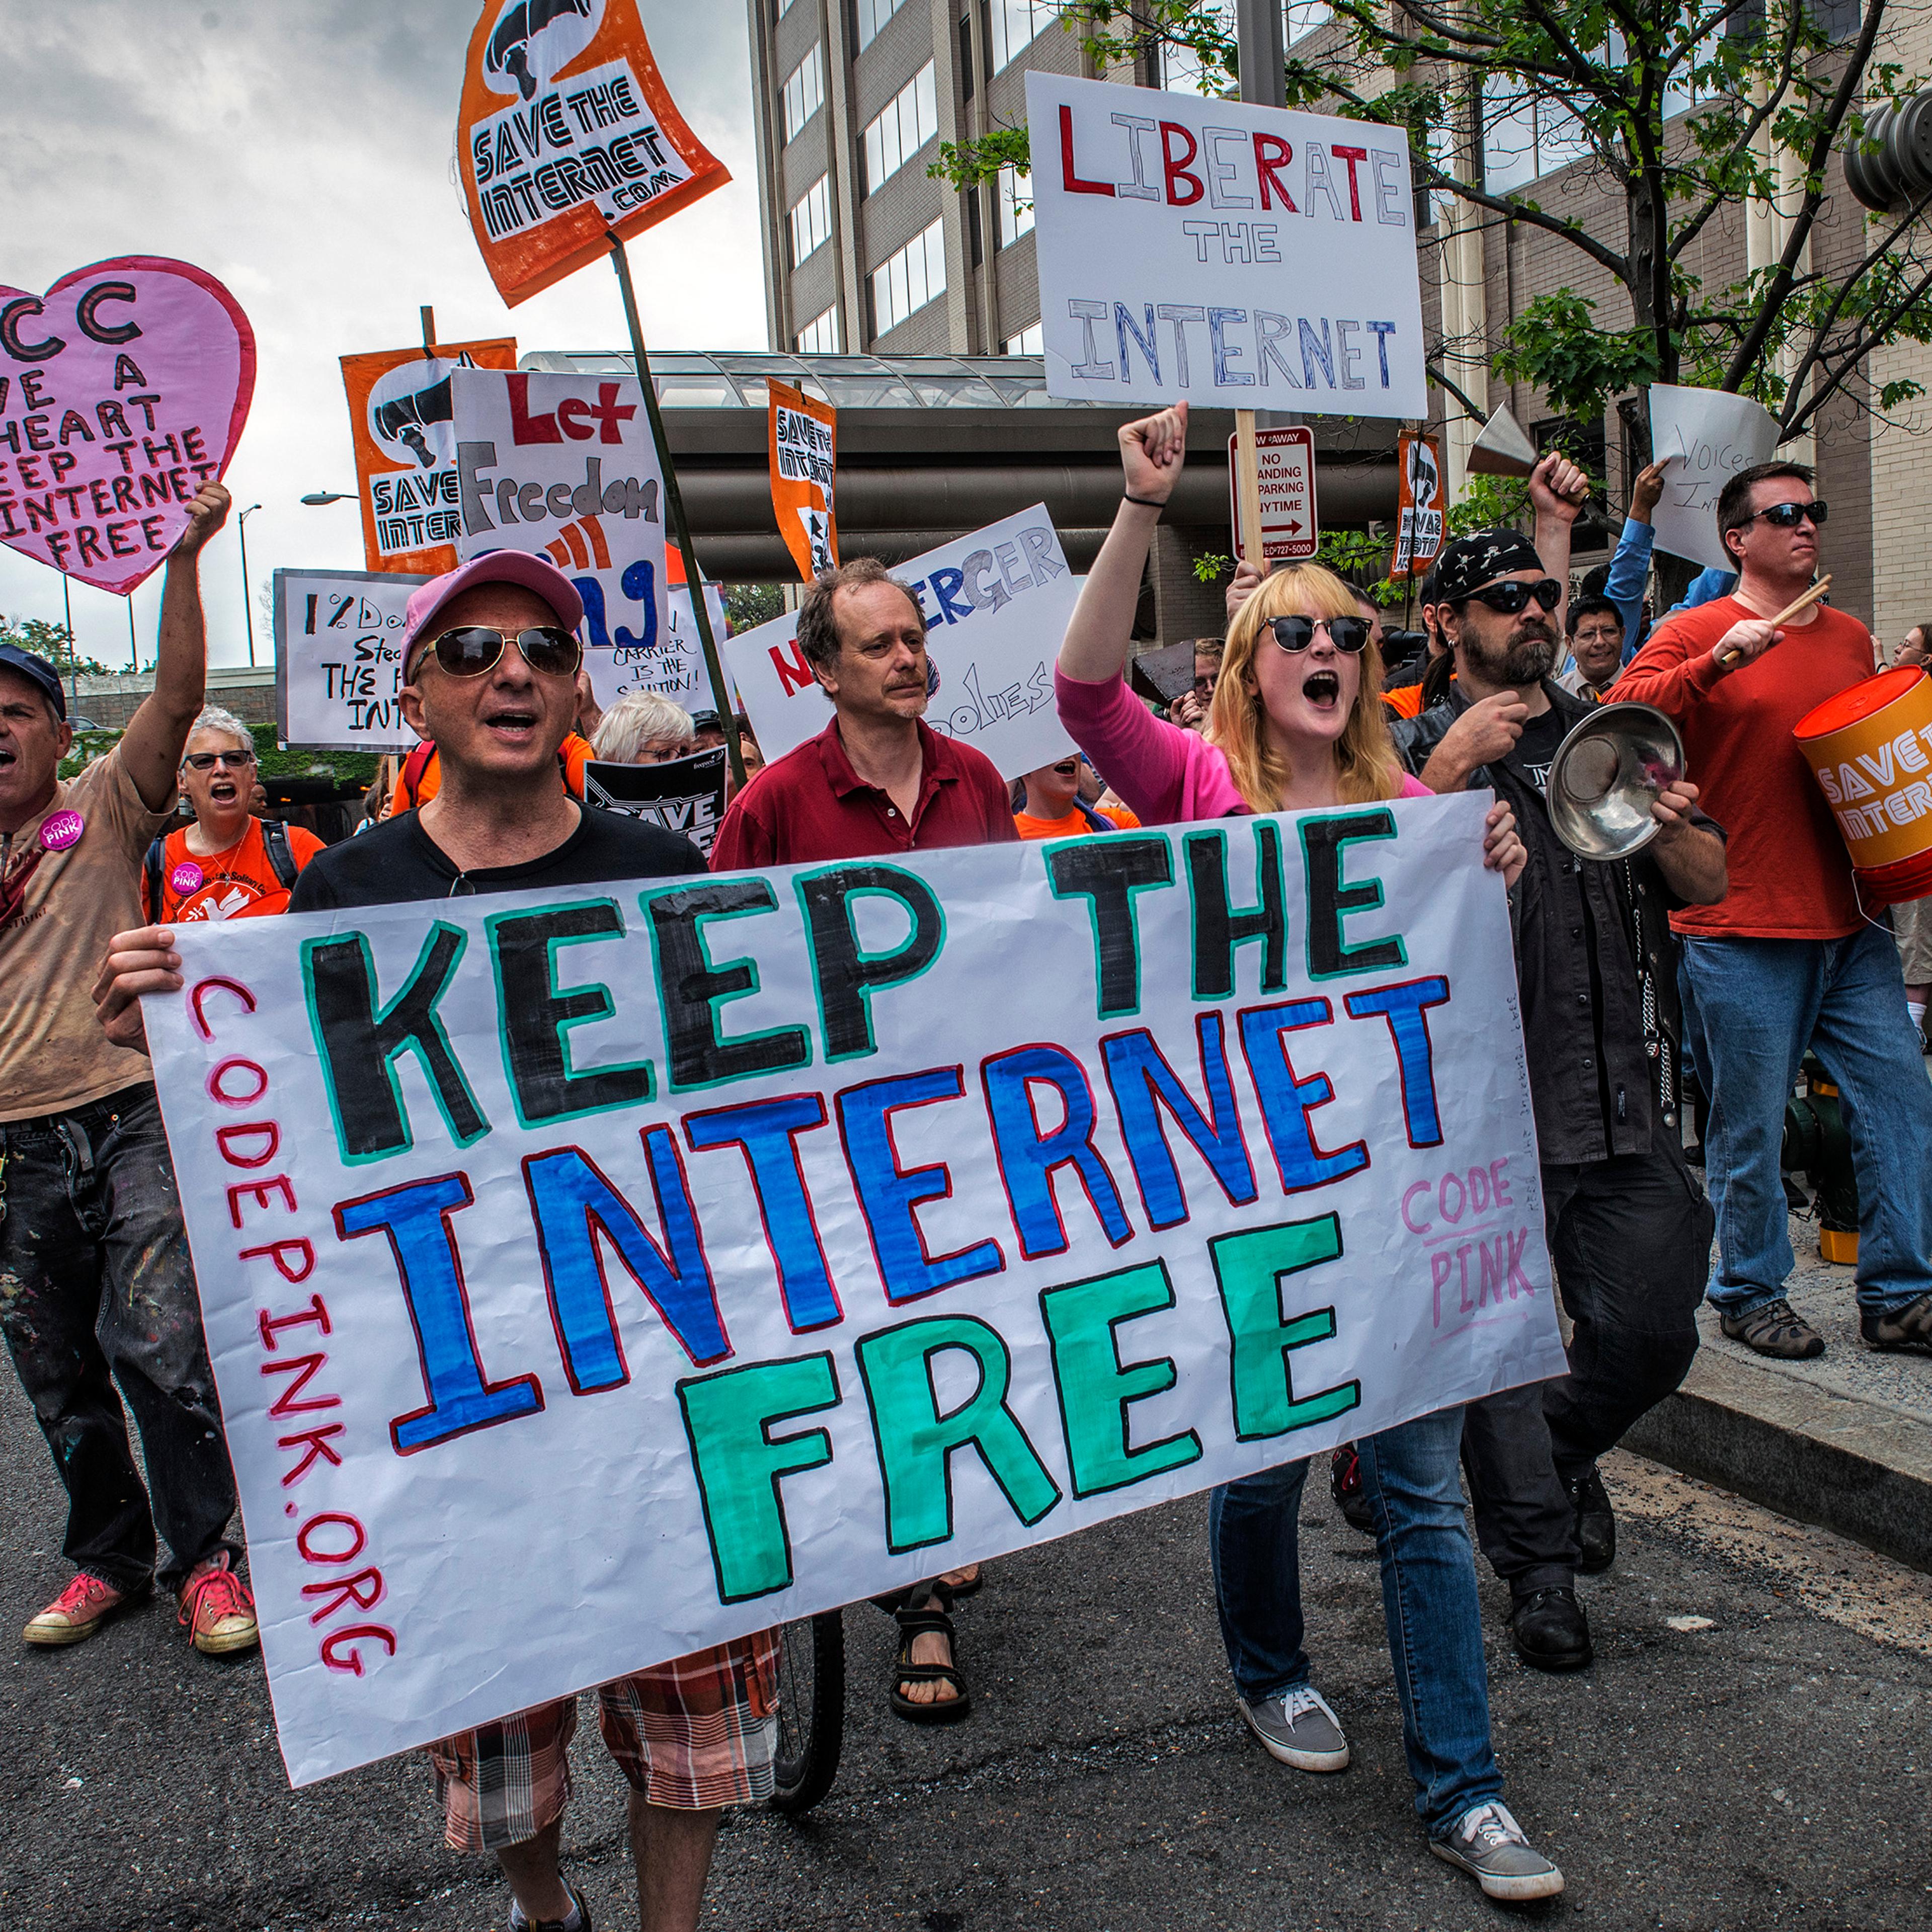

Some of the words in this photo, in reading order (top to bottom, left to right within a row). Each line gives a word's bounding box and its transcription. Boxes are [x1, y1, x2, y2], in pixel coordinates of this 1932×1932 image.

[474, 93, 574, 185] SAVE
[566, 75, 640, 134] THE
[480, 125, 667, 237] INTERNET
[1059, 104, 1405, 226] LIBERATE
[1183, 220, 1281, 263] THE
[1068, 299, 1396, 390] INTERNET
[114, 354, 147, 390] A
[505, 374, 637, 446] Let
[778, 410, 818, 451] SAVE
[815, 429, 832, 452] TH
[104, 425, 205, 473] THE
[1262, 453, 1281, 465] NO
[1271, 433, 1300, 444] AWAY
[373, 470, 459, 515] SAVE
[457, 441, 659, 536] Freedom
[1258, 466, 1302, 480] ANDING
[1258, 481, 1304, 496] PARKING
[46, 514, 167, 570] FREE
[377, 510, 462, 550] INTER
[911, 527, 1065, 632] ERGER
[320, 663, 376, 699] THE
[629, 665, 654, 681] IS
[656, 658, 687, 675] THE
[1818, 729, 1929, 804] SAVE
[42, 813, 78, 836] CODE
[606, 795, 715, 831] AVE
[1837, 775, 1932, 840] INTER
[46, 822, 79, 844] PINK
[173, 877, 197, 888] PINK
[174, 869, 200, 880] CODE
[299, 860, 947, 1169] KEEP
[1042, 807, 1409, 1022] THE
[332, 973, 1451, 1458] INTERNET
[1401, 1156, 1514, 1236] CODE
[1430, 1226, 1536, 1330] PINK
[185, 975, 397, 1677] CODEPINK.ORG
[674, 1211, 1362, 1607] FREE
